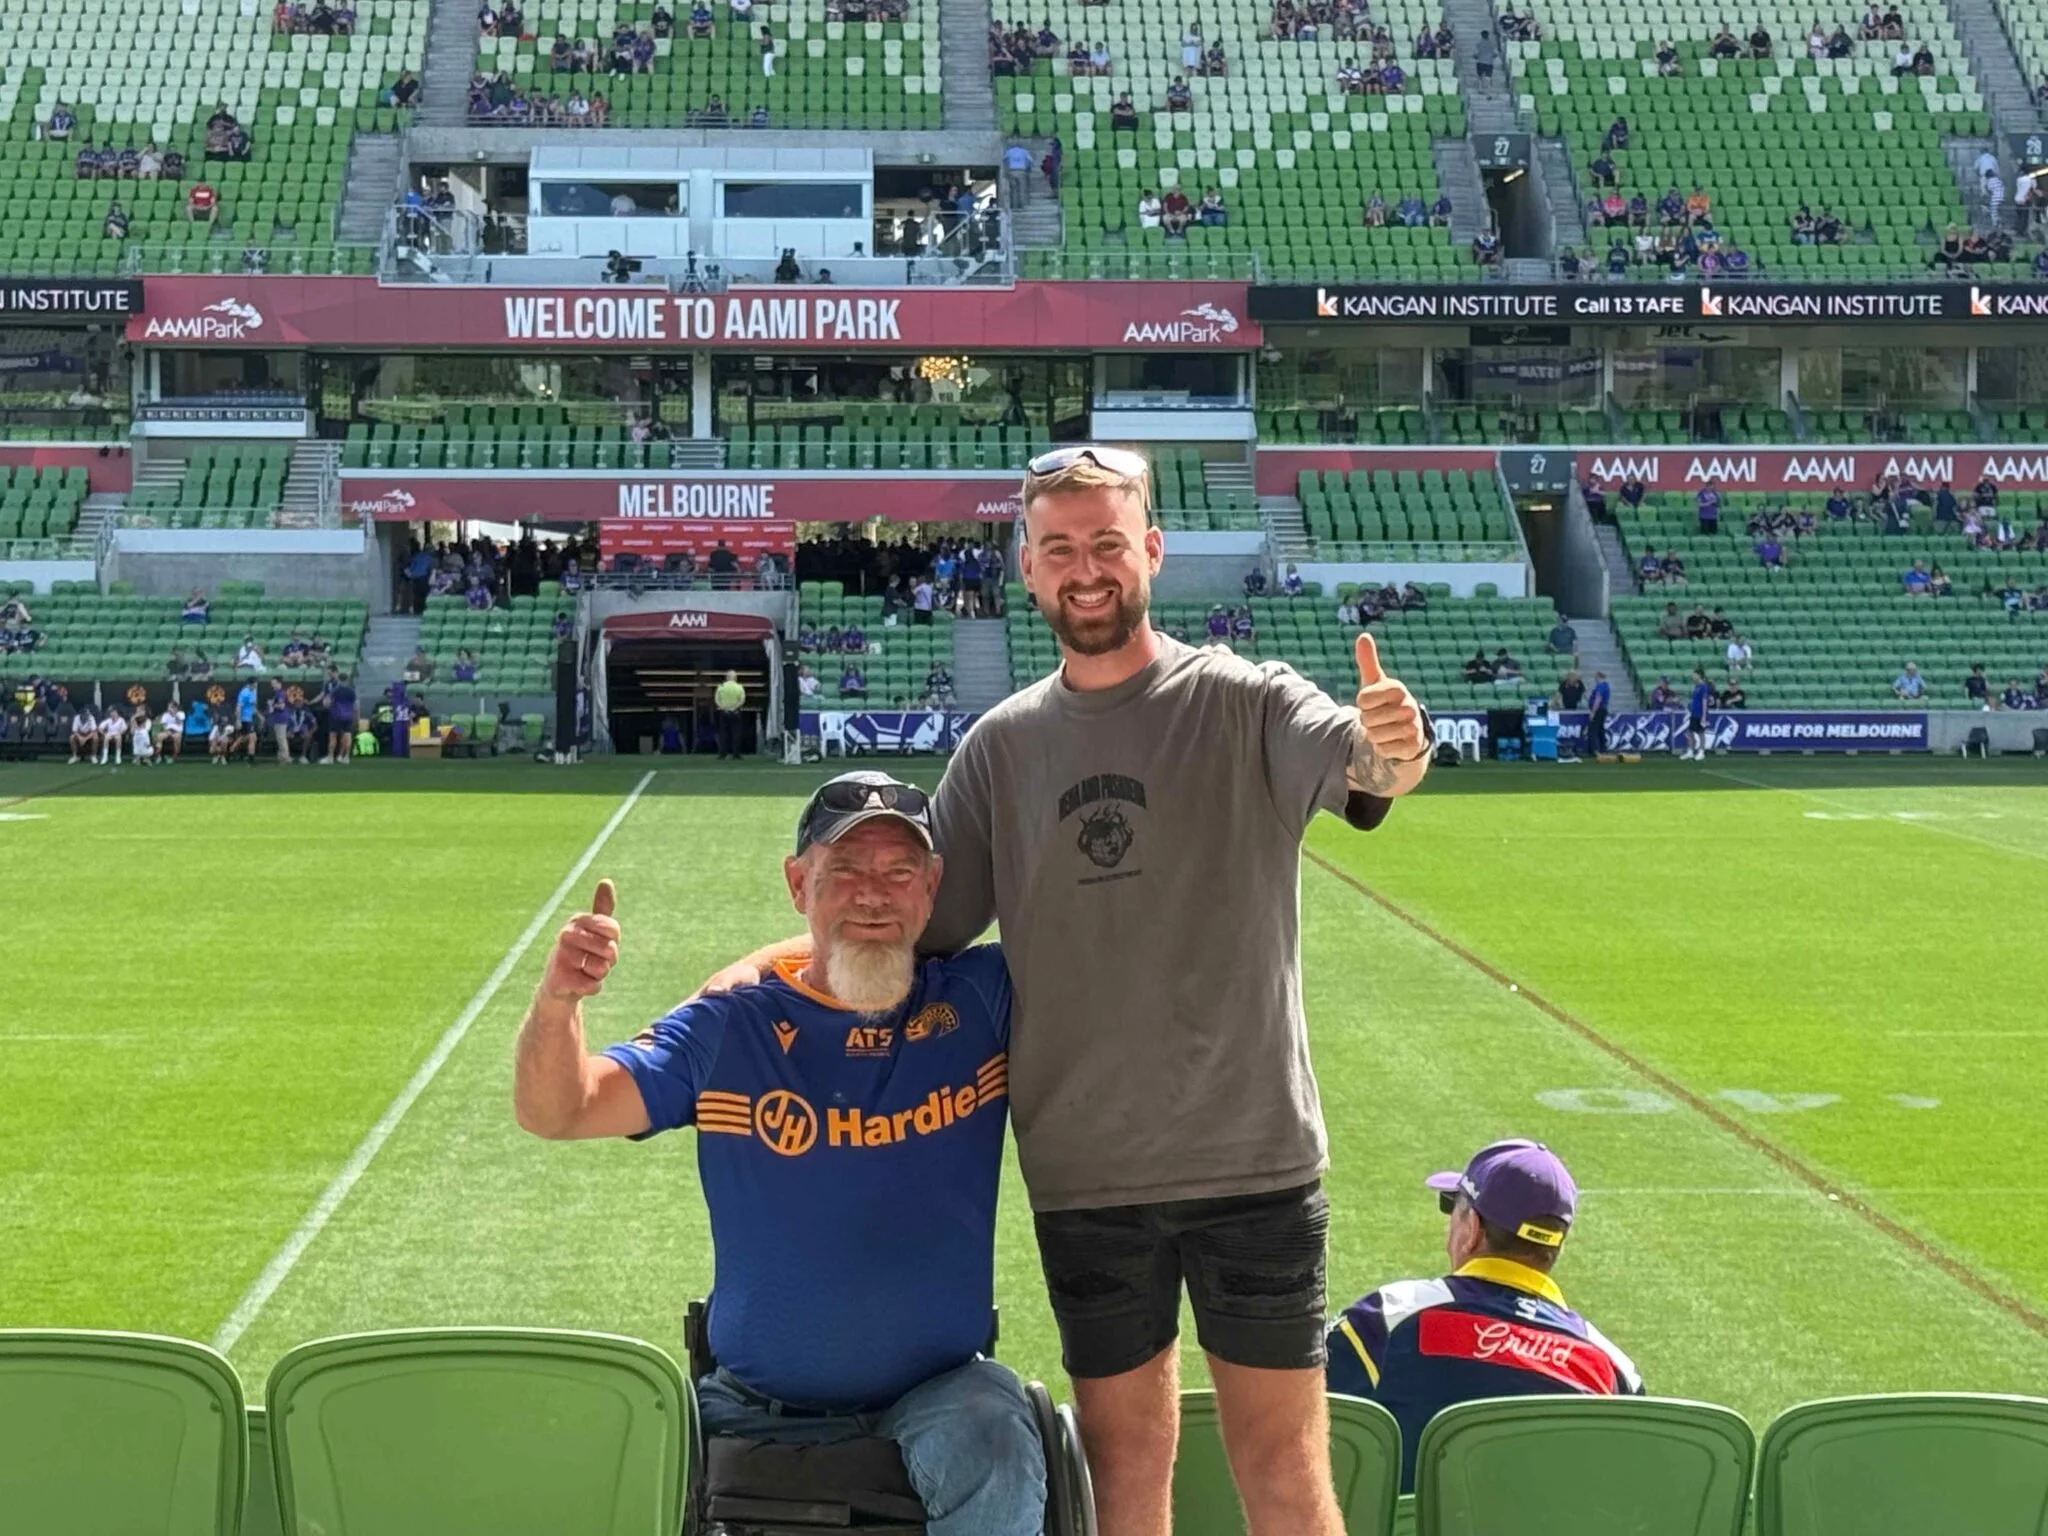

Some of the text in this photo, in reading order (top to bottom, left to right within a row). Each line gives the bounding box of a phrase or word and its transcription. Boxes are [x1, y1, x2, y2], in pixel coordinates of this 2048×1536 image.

[1494, 140, 1510, 156] 27
[11, 289, 129, 311] INSTITUTE
[1344, 296, 1437, 316] KANGAN
[1443, 296, 1557, 316] INSTITUTE
[1574, 298, 1684, 314] Call 13 TAFE
[1728, 296, 1820, 316] KANGAN
[1827, 296, 1943, 315] INSTITUTE
[1998, 295, 2048, 314] KAN
[504, 297, 901, 341] WELCOME TO AAMI PARK
[1531, 458, 1546, 474] 27
[1591, 457, 1659, 482] AAMI
[1684, 457, 1756, 482] AAMI
[1783, 457, 1855, 482] AAMI
[1884, 456, 1953, 482] AAMI
[619, 484, 775, 518] MELBOURNE
[669, 613, 708, 628] AAMI
[1746, 724, 1922, 738] MADE FOR MELBOURNE
[846, 1027, 893, 1048] ATS
[827, 1086, 977, 1147] Hardie
[1473, 1322, 1577, 1369] Grill'd
